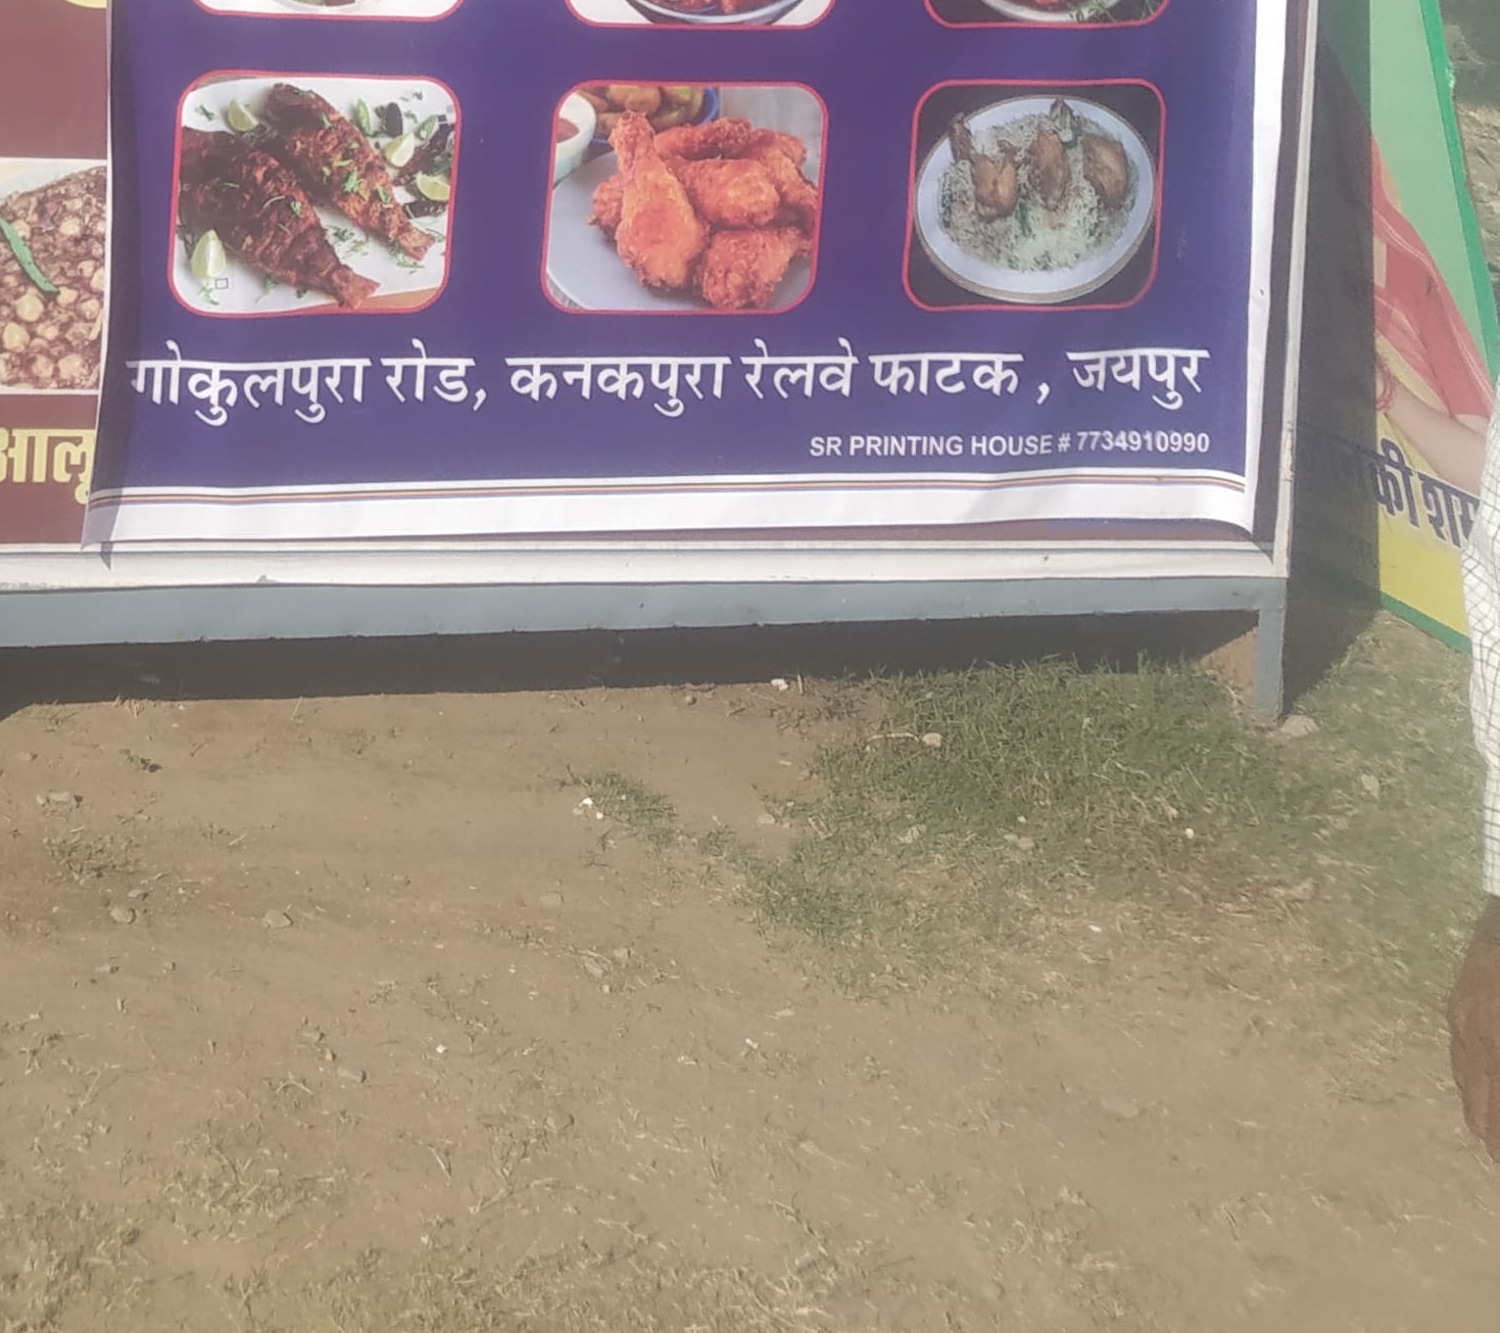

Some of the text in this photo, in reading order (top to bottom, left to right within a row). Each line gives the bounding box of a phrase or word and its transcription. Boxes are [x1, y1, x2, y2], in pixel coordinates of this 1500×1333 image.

[126, 339, 372, 426] गोकुलपुरा
[381, 339, 486, 410] रोड,
[506, 357, 731, 416] कनकपुरा
[740, 338, 858, 398] रेलवे
[1067, 348, 1210, 409] जयपुर
[810, 437, 841, 456] SR
[850, 436, 962, 455] PRINTING
[972, 435, 1052, 456] HOUSE
[1078, 431, 1209, 452] 7734910990
